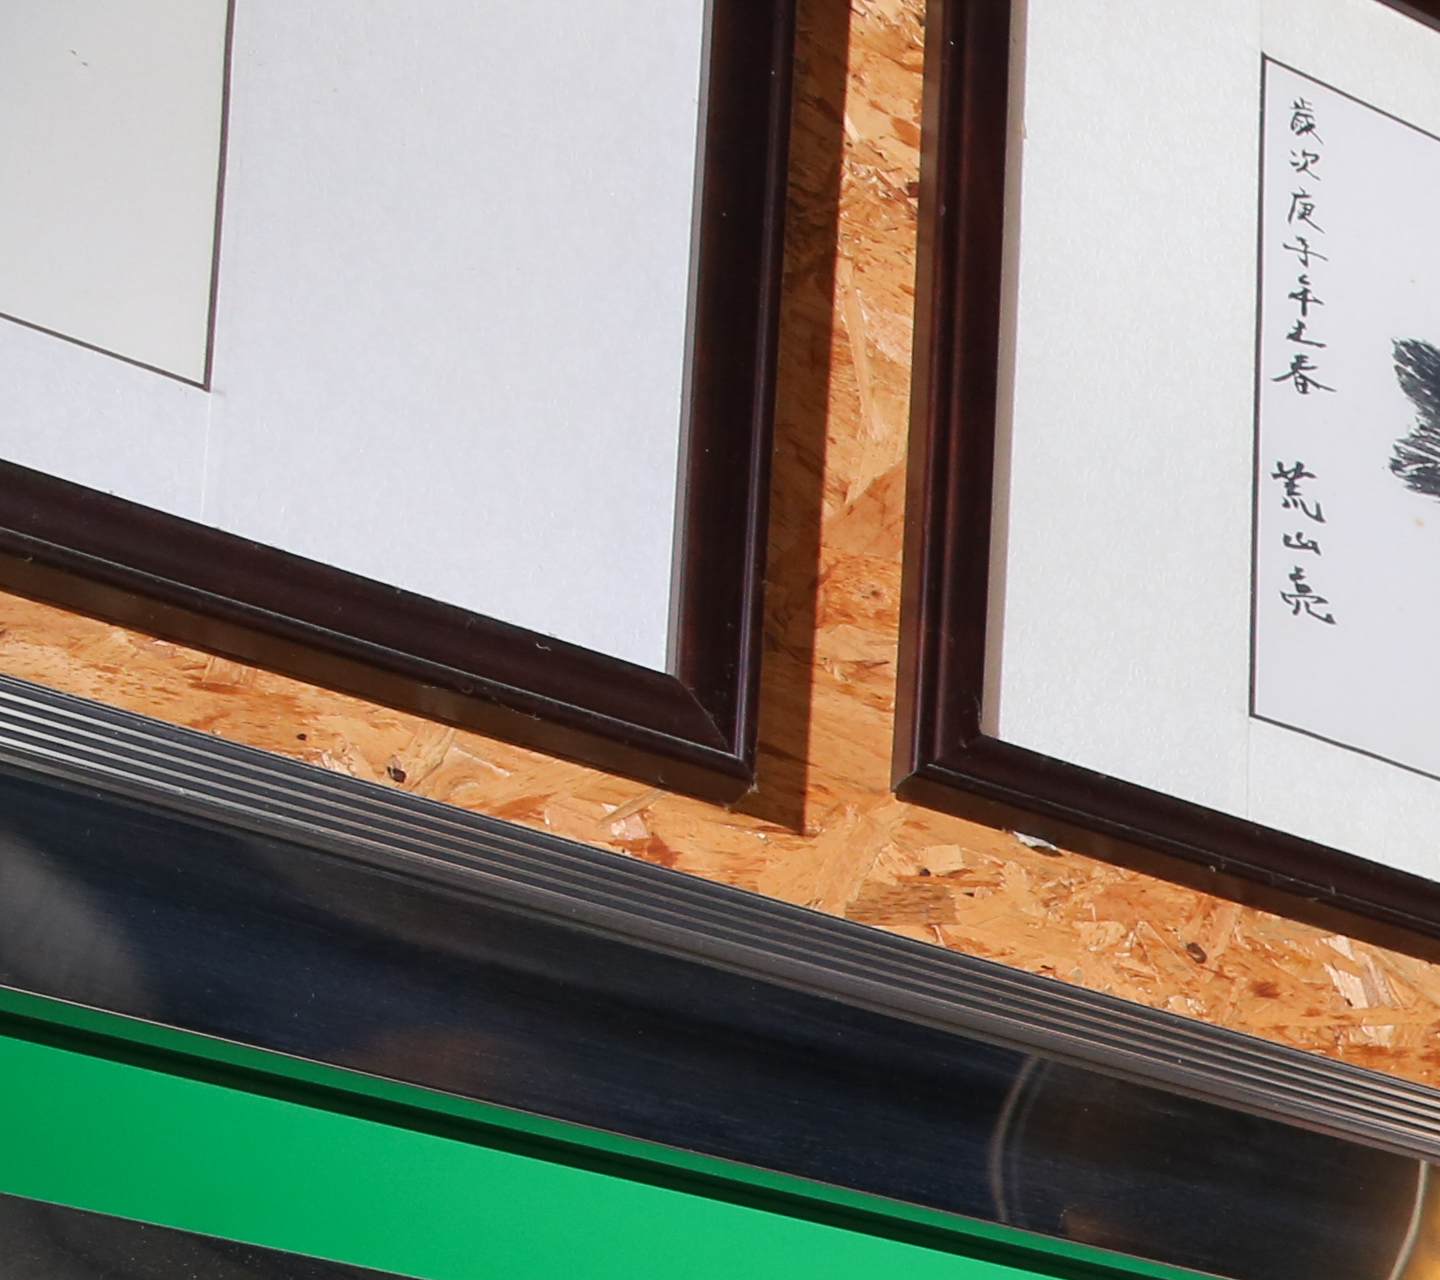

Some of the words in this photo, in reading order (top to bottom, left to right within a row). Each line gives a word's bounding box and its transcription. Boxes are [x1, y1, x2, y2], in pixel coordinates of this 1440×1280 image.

[1271, 97, 1337, 395] 歲次庚子年之春
[1271, 461, 1337, 625] 荒山亮
